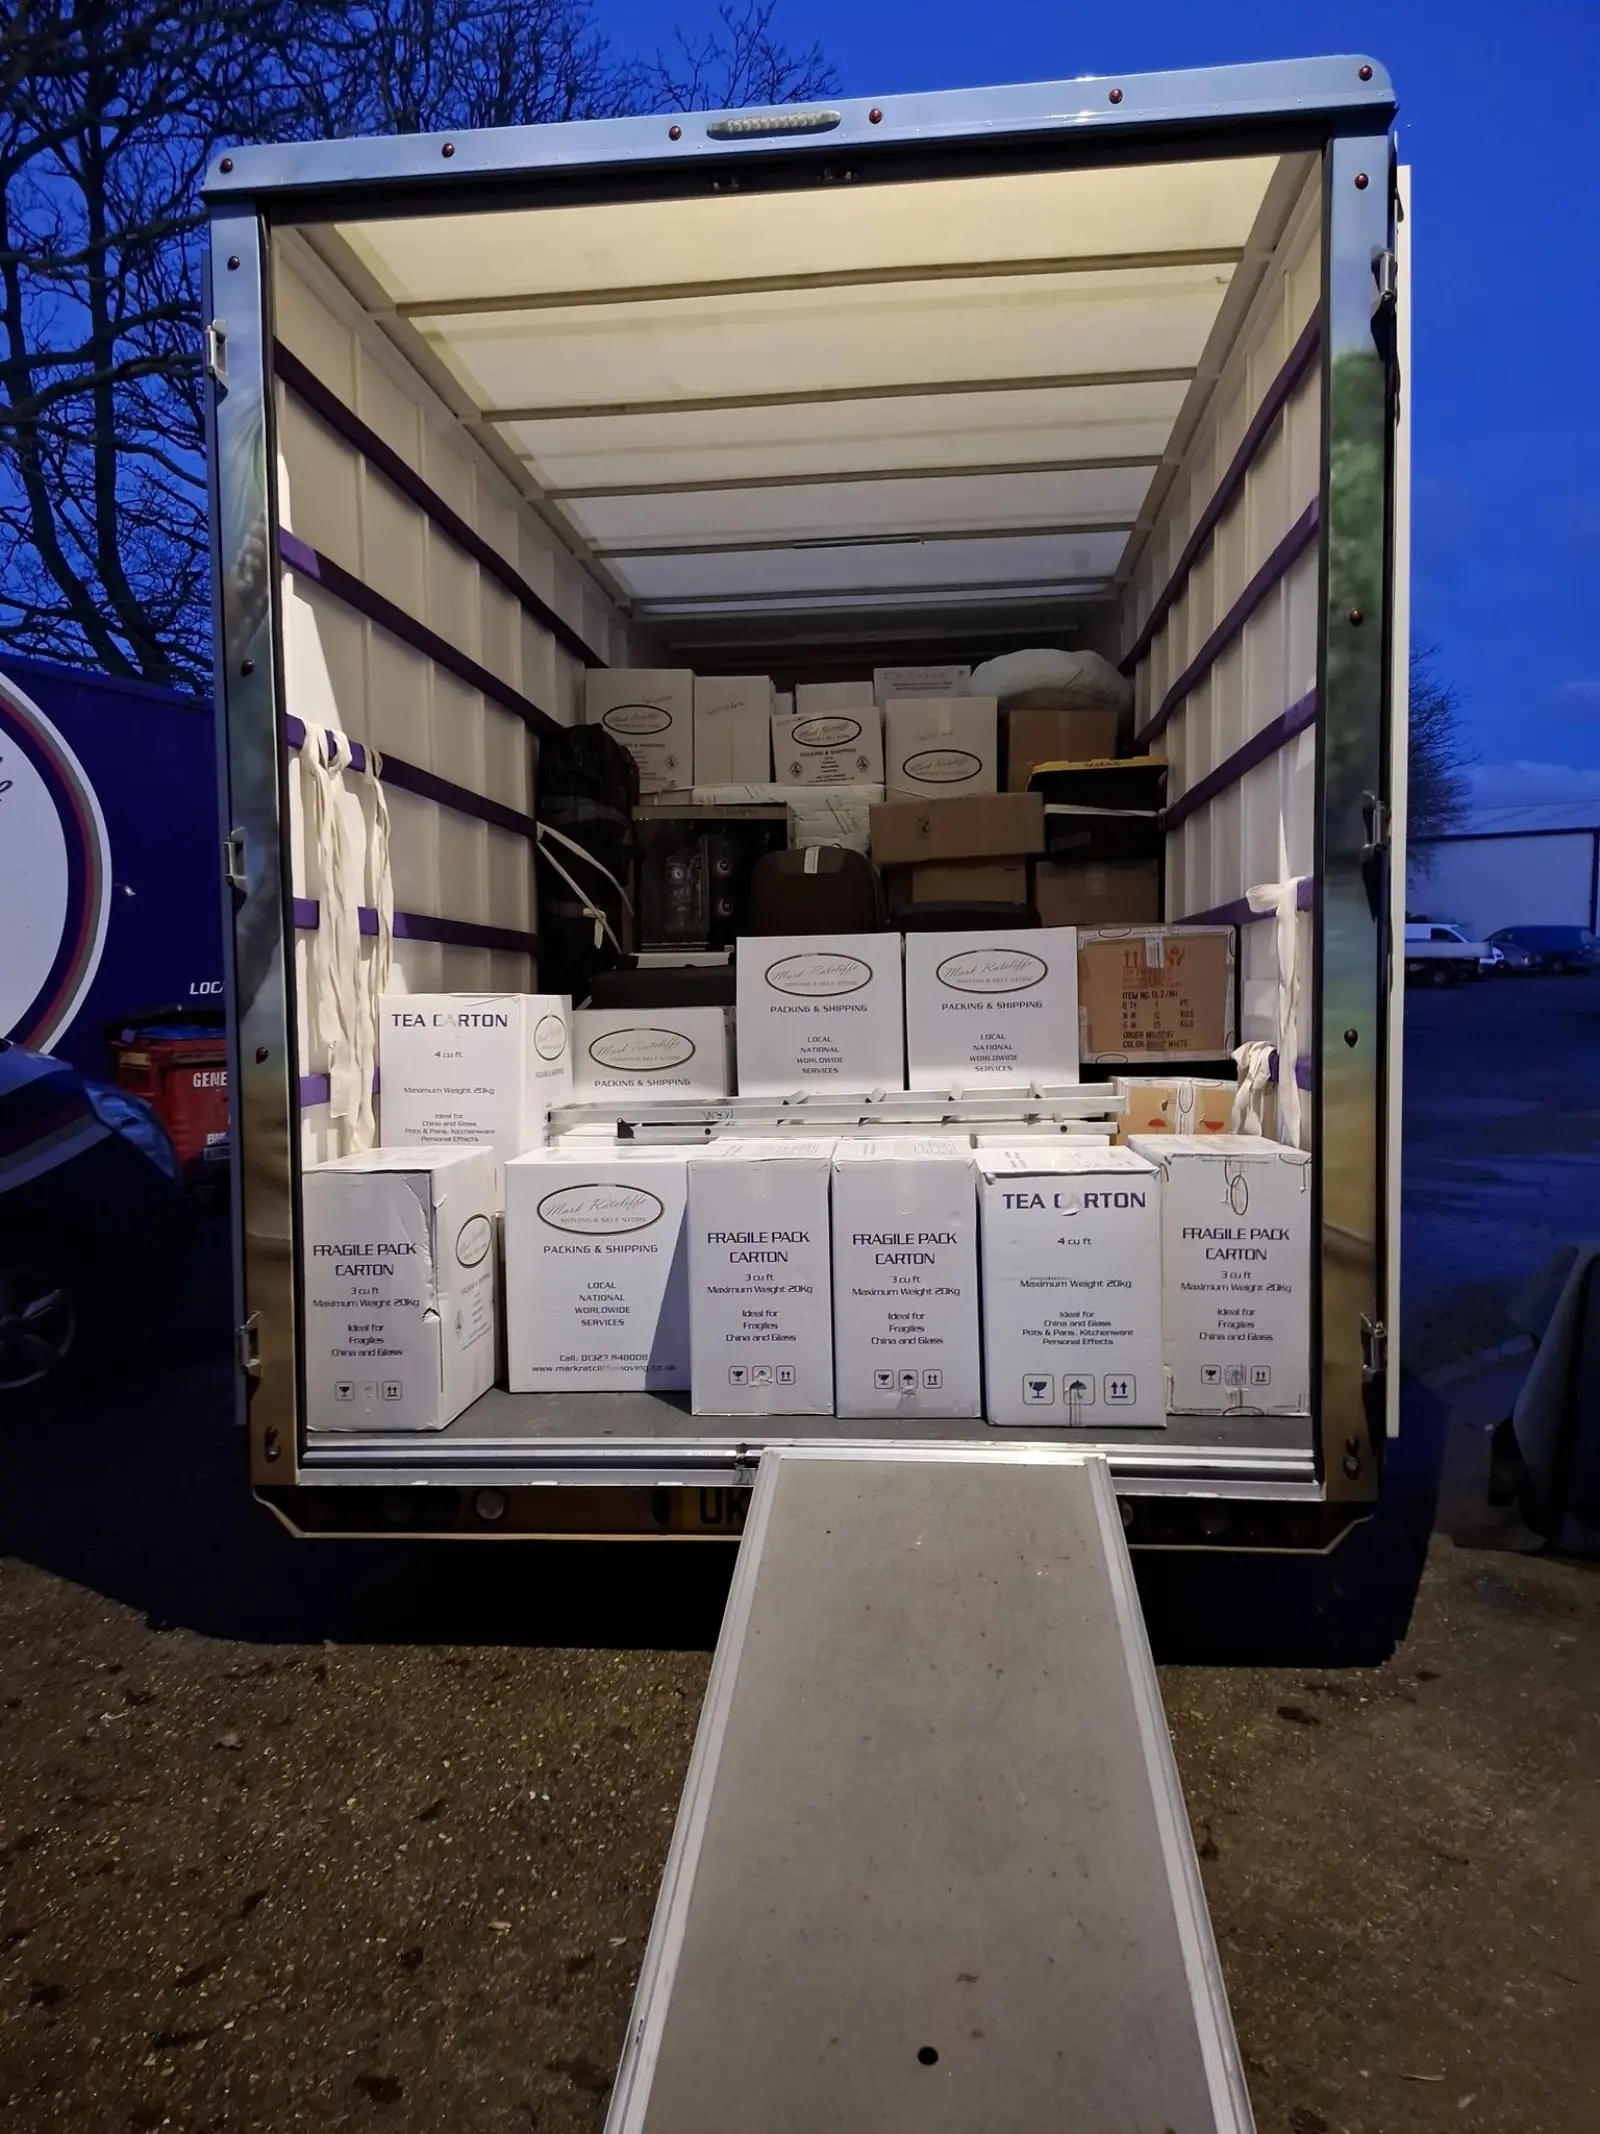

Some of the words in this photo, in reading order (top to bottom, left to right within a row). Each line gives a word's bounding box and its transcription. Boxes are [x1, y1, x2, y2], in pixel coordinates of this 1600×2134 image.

[189, 981, 224, 995] LOC
[770, 1005, 811, 1013] PACKING
[823, 1004, 868, 1012] SHIPPING
[942, 1003, 984, 1011] PACKING
[986, 1002, 993, 1010] &
[996, 1001, 1043, 1009] SHIPPING
[391, 1014, 426, 1027] TEA
[969, 1054, 1018, 1062] WORLDWIDE
[594, 1079, 635, 1088] PACKING
[638, 1079, 644, 1087] &
[647, 1078, 691, 1087] SHIPPING
[444, 1087, 471, 1095] Weight
[1002, 1193, 1046, 1209] TEA
[1054, 1192, 1146, 1209] CRTON
[545, 1202, 585, 1217] Mark
[589, 1194, 648, 1211] Ratcliffe
[708, 1232, 769, 1244] FRAGILE
[772, 1231, 811, 1243] PACK
[852, 1233, 915, 1245] FRAGILE
[918, 1232, 958, 1245] PACK
[1182, 1227, 1247, 1240] FRAGILE
[1250, 1228, 1290, 1241] PACK
[313, 1244, 374, 1257] FRAGILE
[377, 1243, 418, 1256] PACK
[543, 1245, 591, 1254] PACKING
[594, 1245, 602, 1254] &
[606, 1244, 659, 1253] SHIPPING
[730, 1251, 789, 1263] CARTON
[875, 1252, 936, 1265] CARTON
[1206, 1248, 1268, 1261] CARTON
[335, 1264, 395, 1276] CARTON
[1220, 1270, 1228, 1279] 3
[1244, 1270, 1252, 1279] ft
[744, 1274, 751, 1282] 3
[752, 1274, 765, 1282] cu
[891, 1276, 898, 1284] 3
[898, 1276, 911, 1284] cu
[912, 1276, 921, 1284] ft
[1020, 1280, 1068, 1288] Maximum
[1070, 1280, 1104, 1289] Weight
[1180, 1282, 1229, 1291] Maximum
[1230, 1283, 1264, 1293] Weight
[350, 1287, 357, 1295] 3
[372, 1287, 380, 1295] ft
[707, 1286, 753, 1294] Maximum
[754, 1286, 785, 1295] Weight
[852, 1288, 899, 1296] Maximum
[900, 1288, 933, 1297] Weight
[312, 1300, 358, 1308] Maximum
[360, 1299, 391, 1309] Weight
[574, 1306, 631, 1314] WORLDWIDE
[1217, 1308, 1240, 1316] Ideal
[1242, 1308, 1256, 1316] for
[888, 1312, 910, 1320] Ideal
[912, 1312, 926, 1320] for
[581, 1318, 625, 1327] SERVICES
[743, 1322, 779, 1331] Fragiles
[1218, 1320, 1255, 1330] Fragiles
[348, 1324, 370, 1332] Ideal
[372, 1324, 385, 1332] for
[888, 1324, 925, 1334] Fragiles
[726, 1334, 751, 1342] China
[871, 1336, 897, 1345] China
[898, 1336, 917, 1345] and
[918, 1336, 944, 1345] Glass
[1199, 1332, 1226, 1340] China
[1227, 1333, 1246, 1341] and
[1247, 1333, 1274, 1341] Glass
[348, 1337, 385, 1346] Fragiles
[331, 1349, 357, 1357] China
[358, 1349, 376, 1357] and
[378, 1349, 403, 1357] Glass
